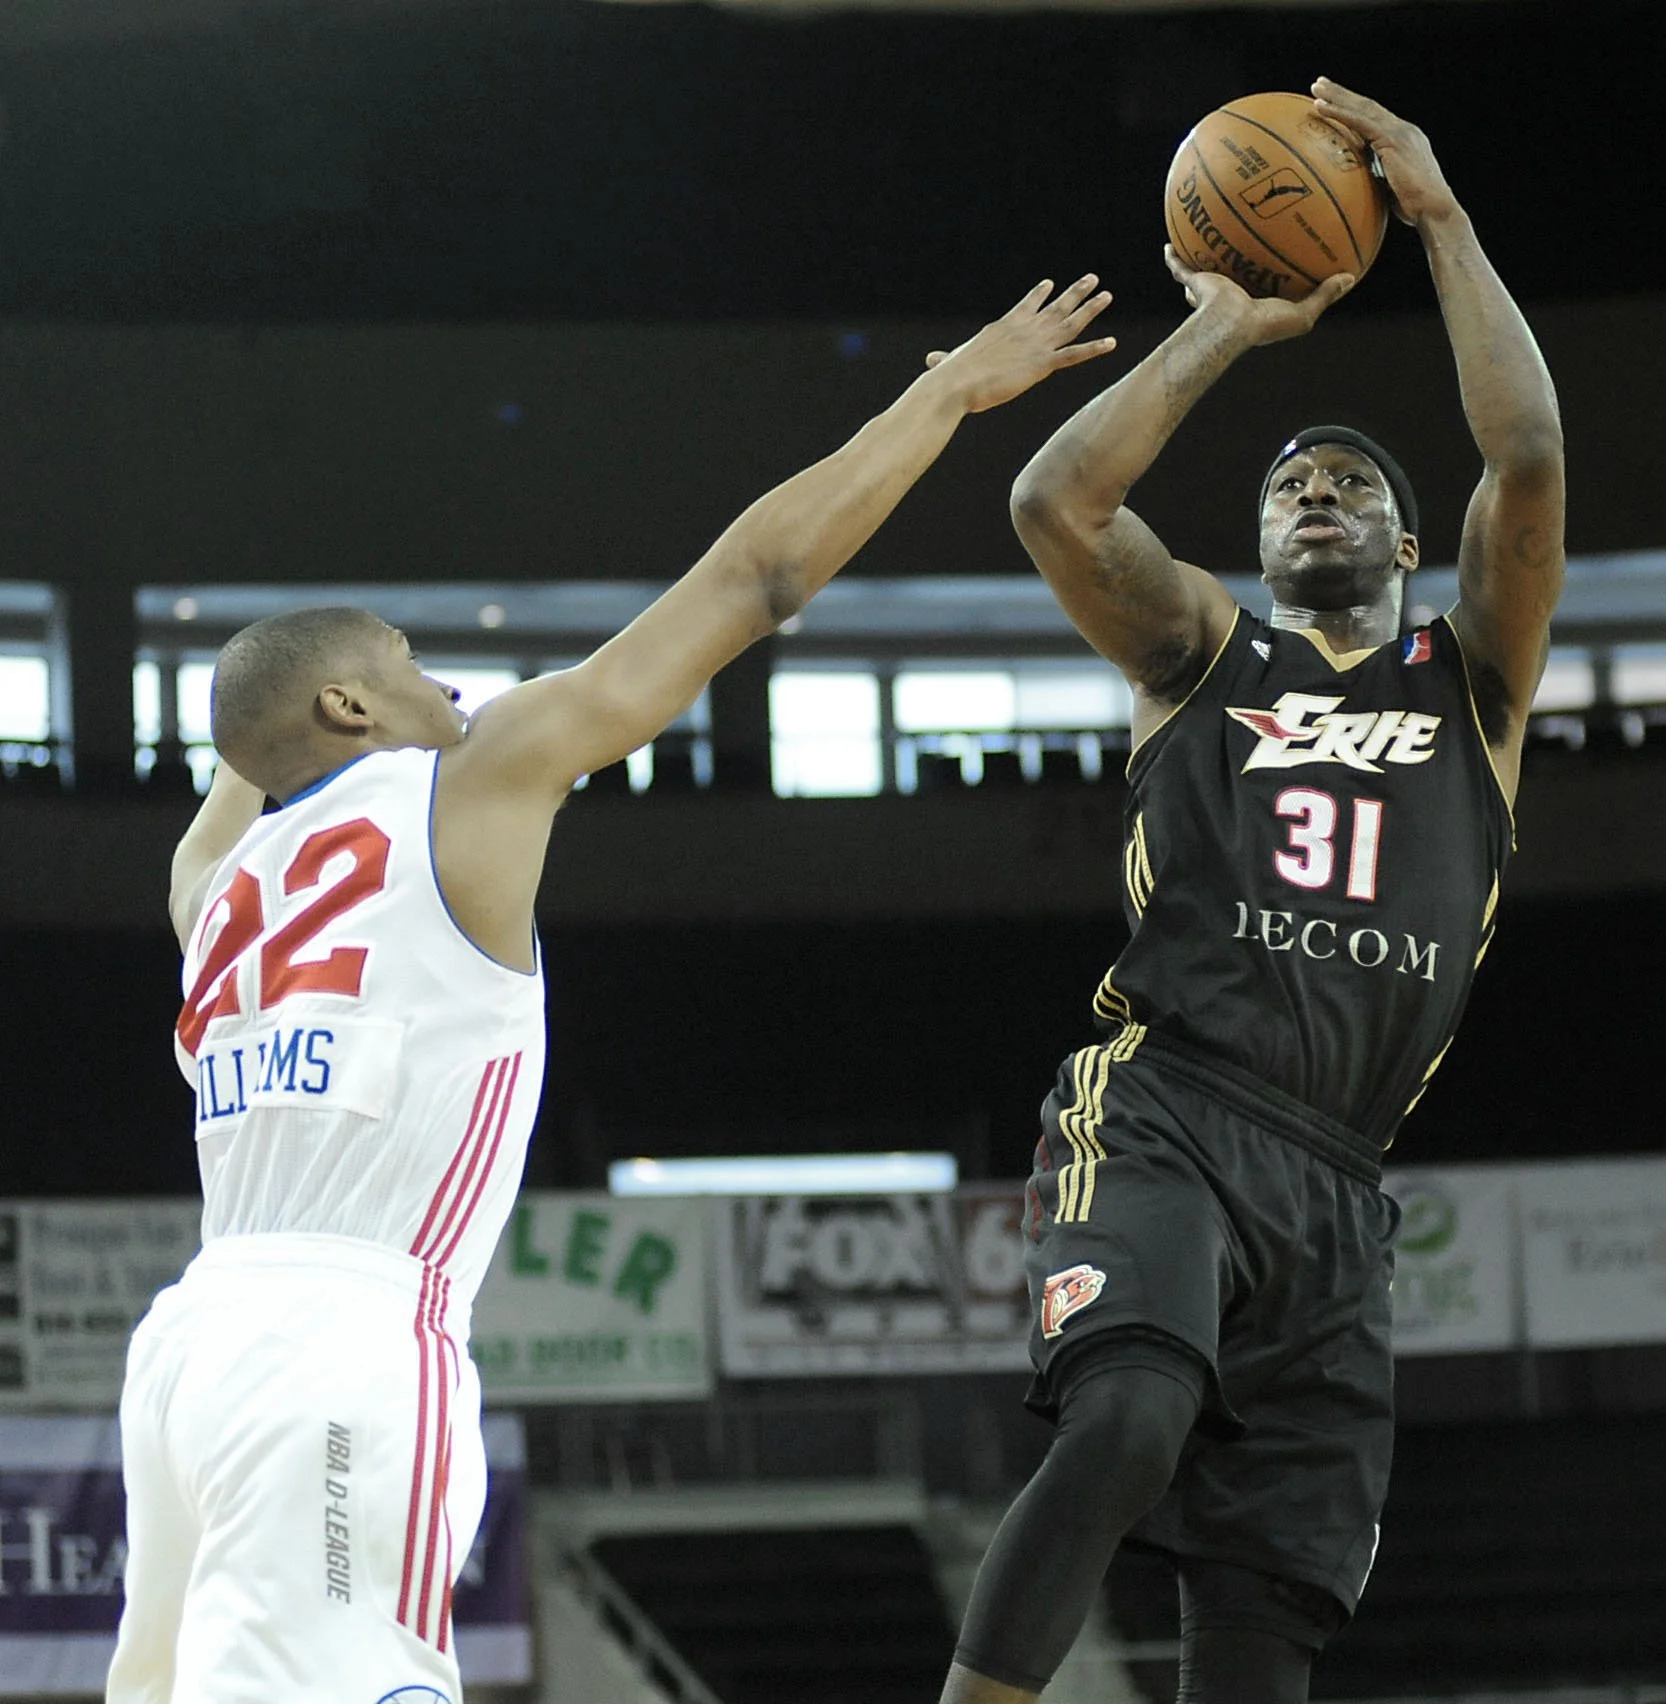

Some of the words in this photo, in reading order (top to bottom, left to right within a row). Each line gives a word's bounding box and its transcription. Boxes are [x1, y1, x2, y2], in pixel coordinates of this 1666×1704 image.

[1177, 172, 1292, 297] SPALDING
[1225, 692, 1442, 775] ERIE
[1275, 786, 1382, 901] 31
[175, 817, 391, 1058] 22
[761, 1200, 938, 1290] FOX
[967, 1203, 1024, 1291] 6
[327, 1420, 351, 1474] NBA
[325, 1478, 351, 1604] D-LEAGUE
